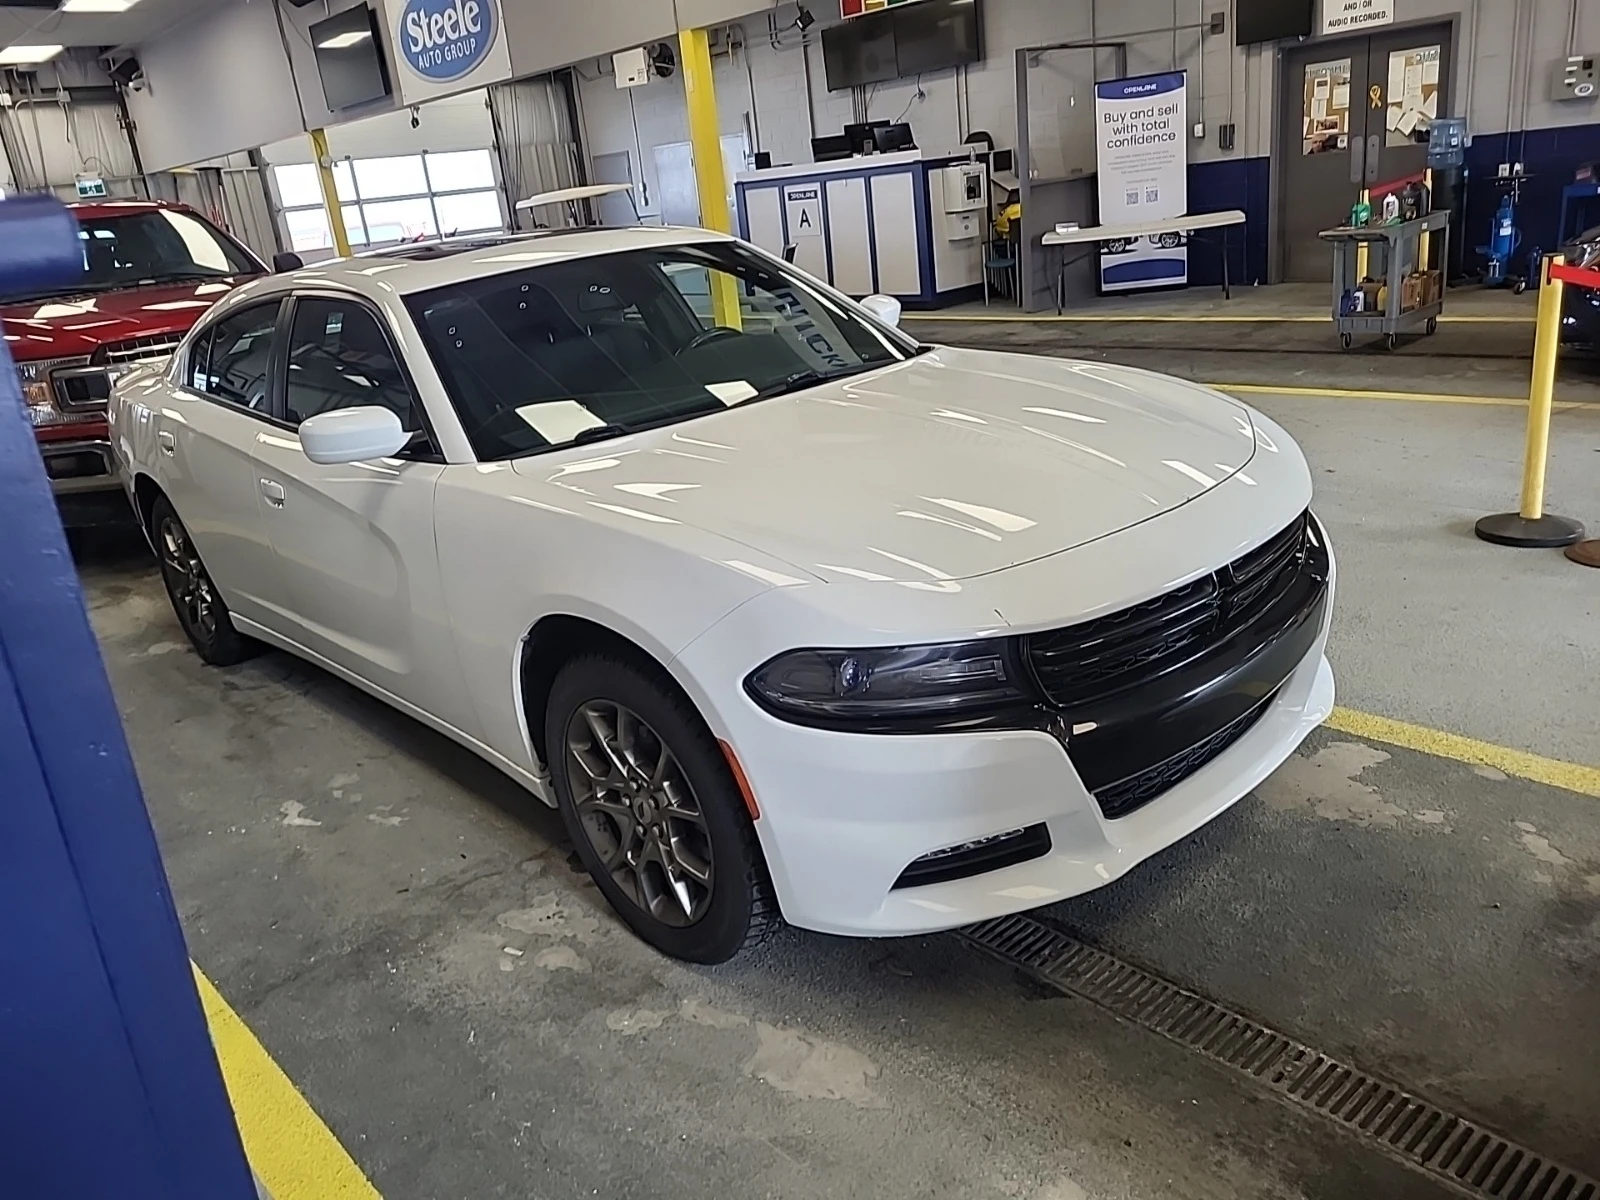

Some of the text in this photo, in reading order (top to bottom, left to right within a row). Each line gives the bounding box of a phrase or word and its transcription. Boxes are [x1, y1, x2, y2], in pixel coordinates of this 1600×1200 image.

[1343, 2, 1358, 11] AND
[406, 0, 481, 53] Steele
[1328, 10, 1388, 28] AUDIO RECORDED.
[418, 37, 476, 70] AUTO GROUP
[1123, 83, 1157, 94] OPENLANE
[1104, 103, 1178, 124] Buy and sell
[1112, 117, 1170, 136] with total
[1107, 132, 1176, 149] confidence
[799, 208, 811, 228] A
